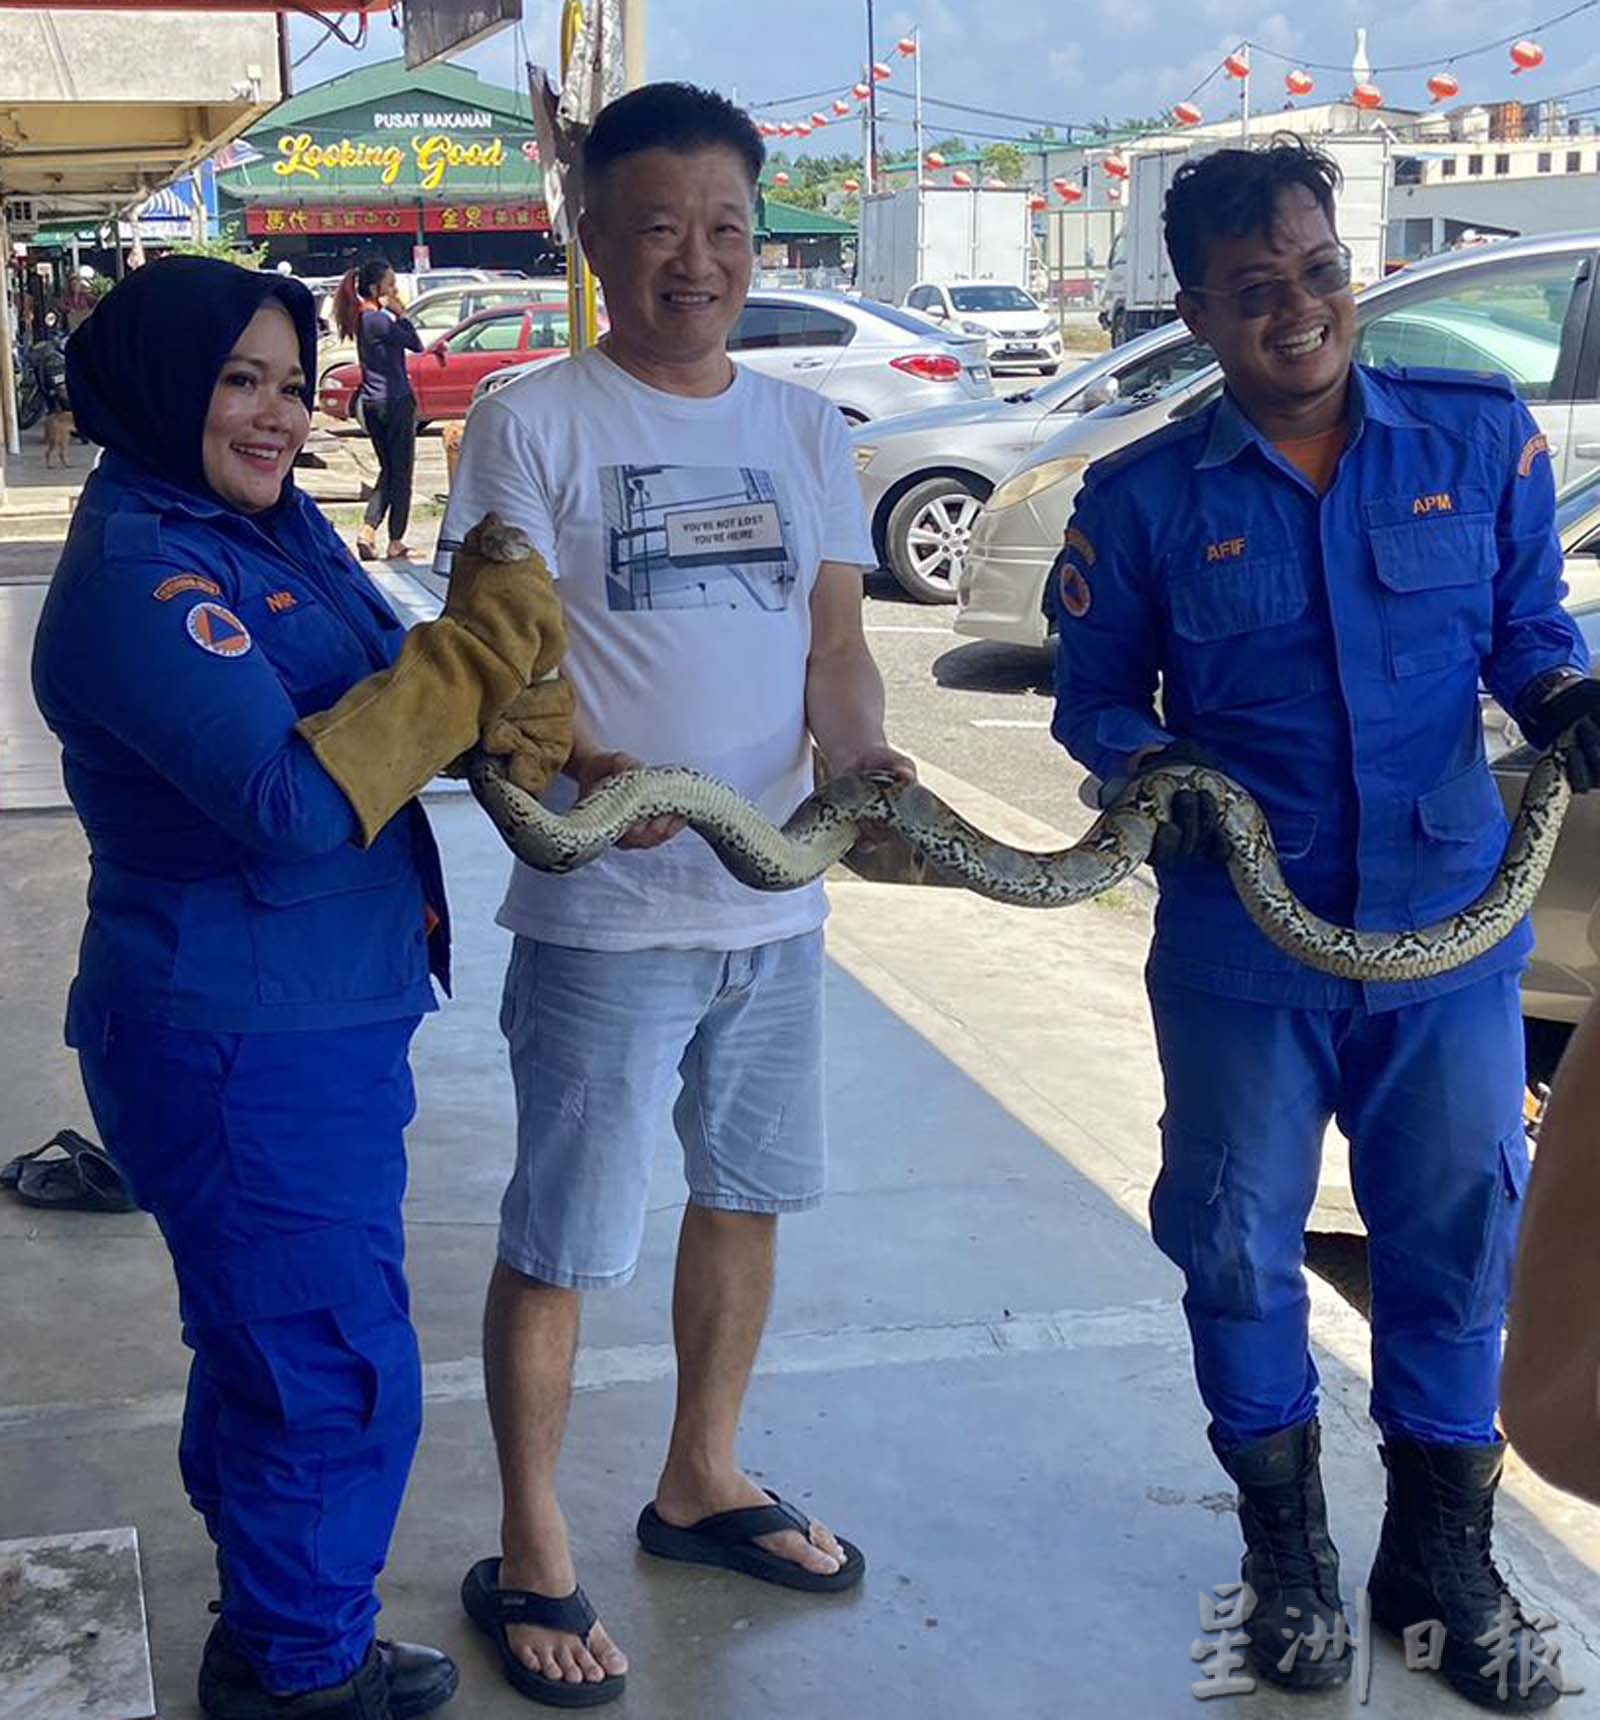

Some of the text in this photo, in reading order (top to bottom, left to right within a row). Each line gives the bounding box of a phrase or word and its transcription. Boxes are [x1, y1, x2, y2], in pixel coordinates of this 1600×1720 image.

[374, 113, 492, 128] PUSAT MAKANAN
[273, 133, 507, 190] Looking Good
[1412, 492, 1453, 515] APM
[717, 518, 735, 529] NOT
[1206, 537, 1248, 562] AFIF
